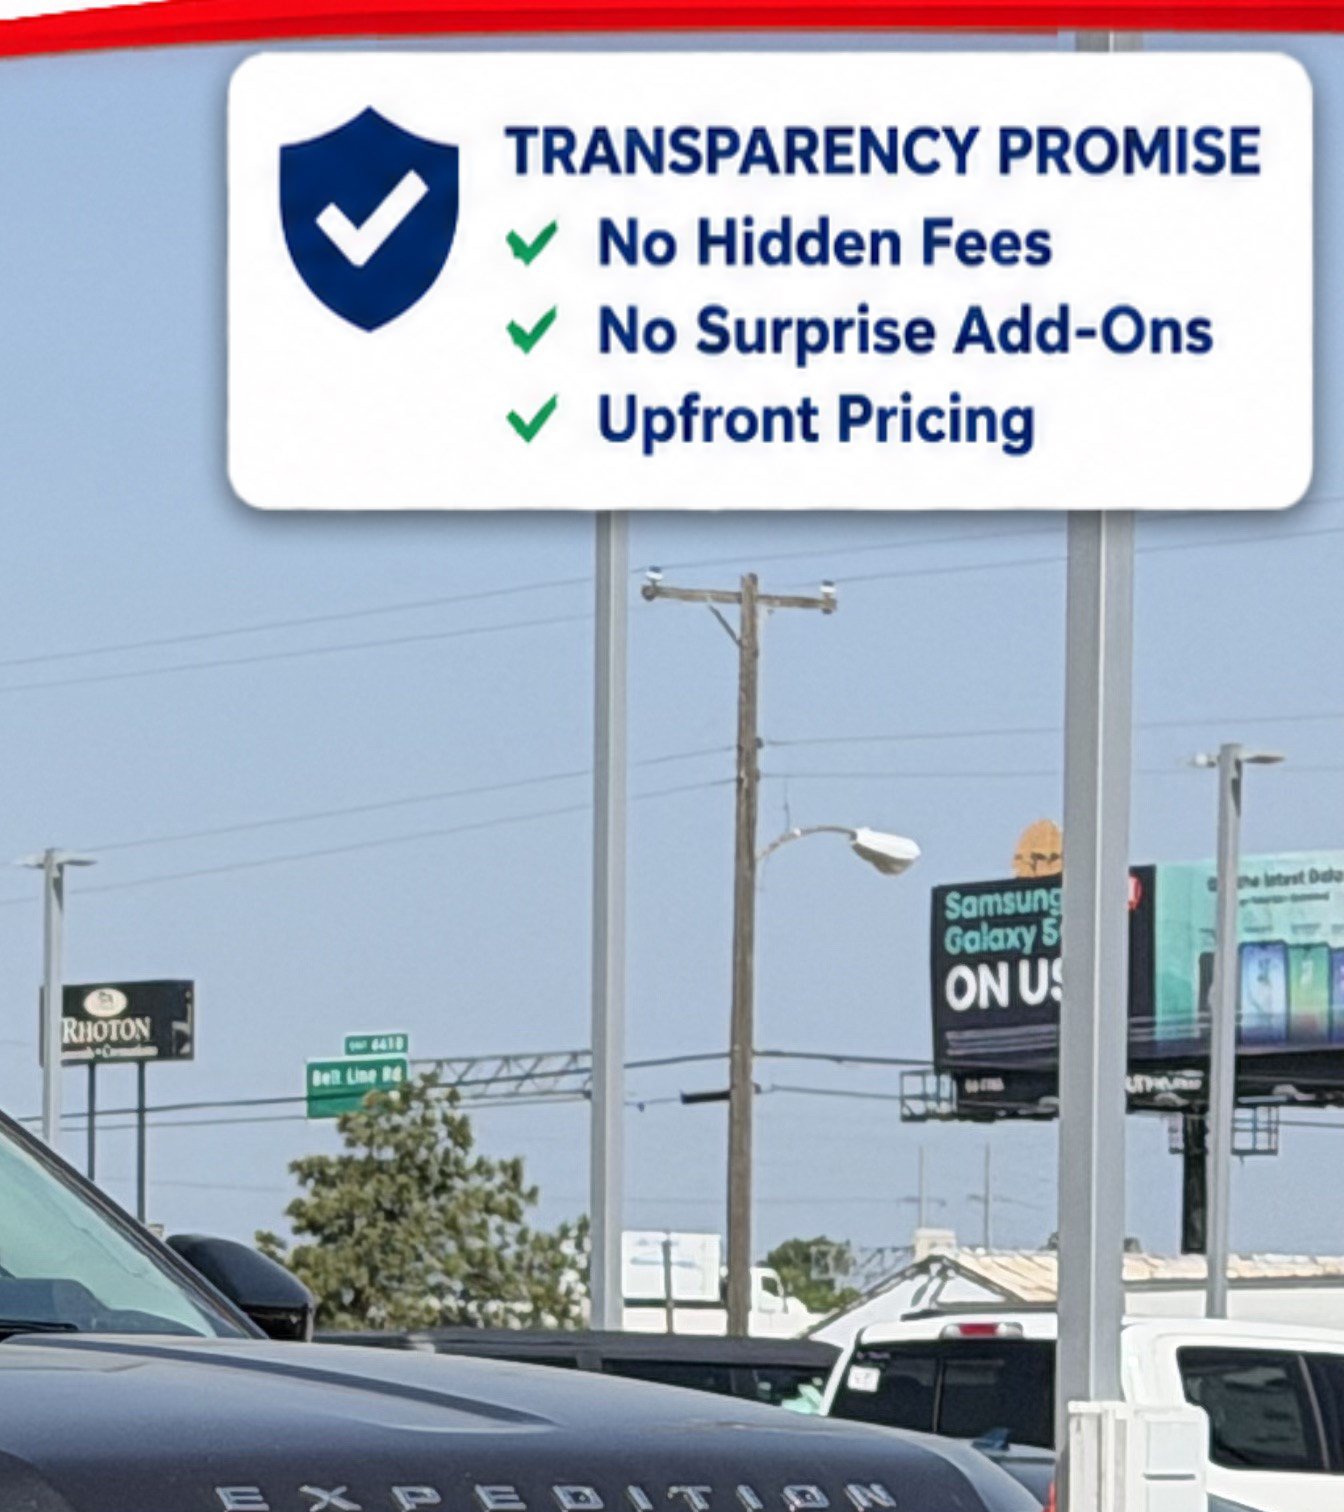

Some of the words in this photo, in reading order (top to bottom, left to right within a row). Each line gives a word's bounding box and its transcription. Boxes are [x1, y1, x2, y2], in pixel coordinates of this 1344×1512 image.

[944, 921, 1037, 955] Galaxy
[945, 961, 1010, 1011] ON
[62, 1015, 152, 1044] RHOTON
